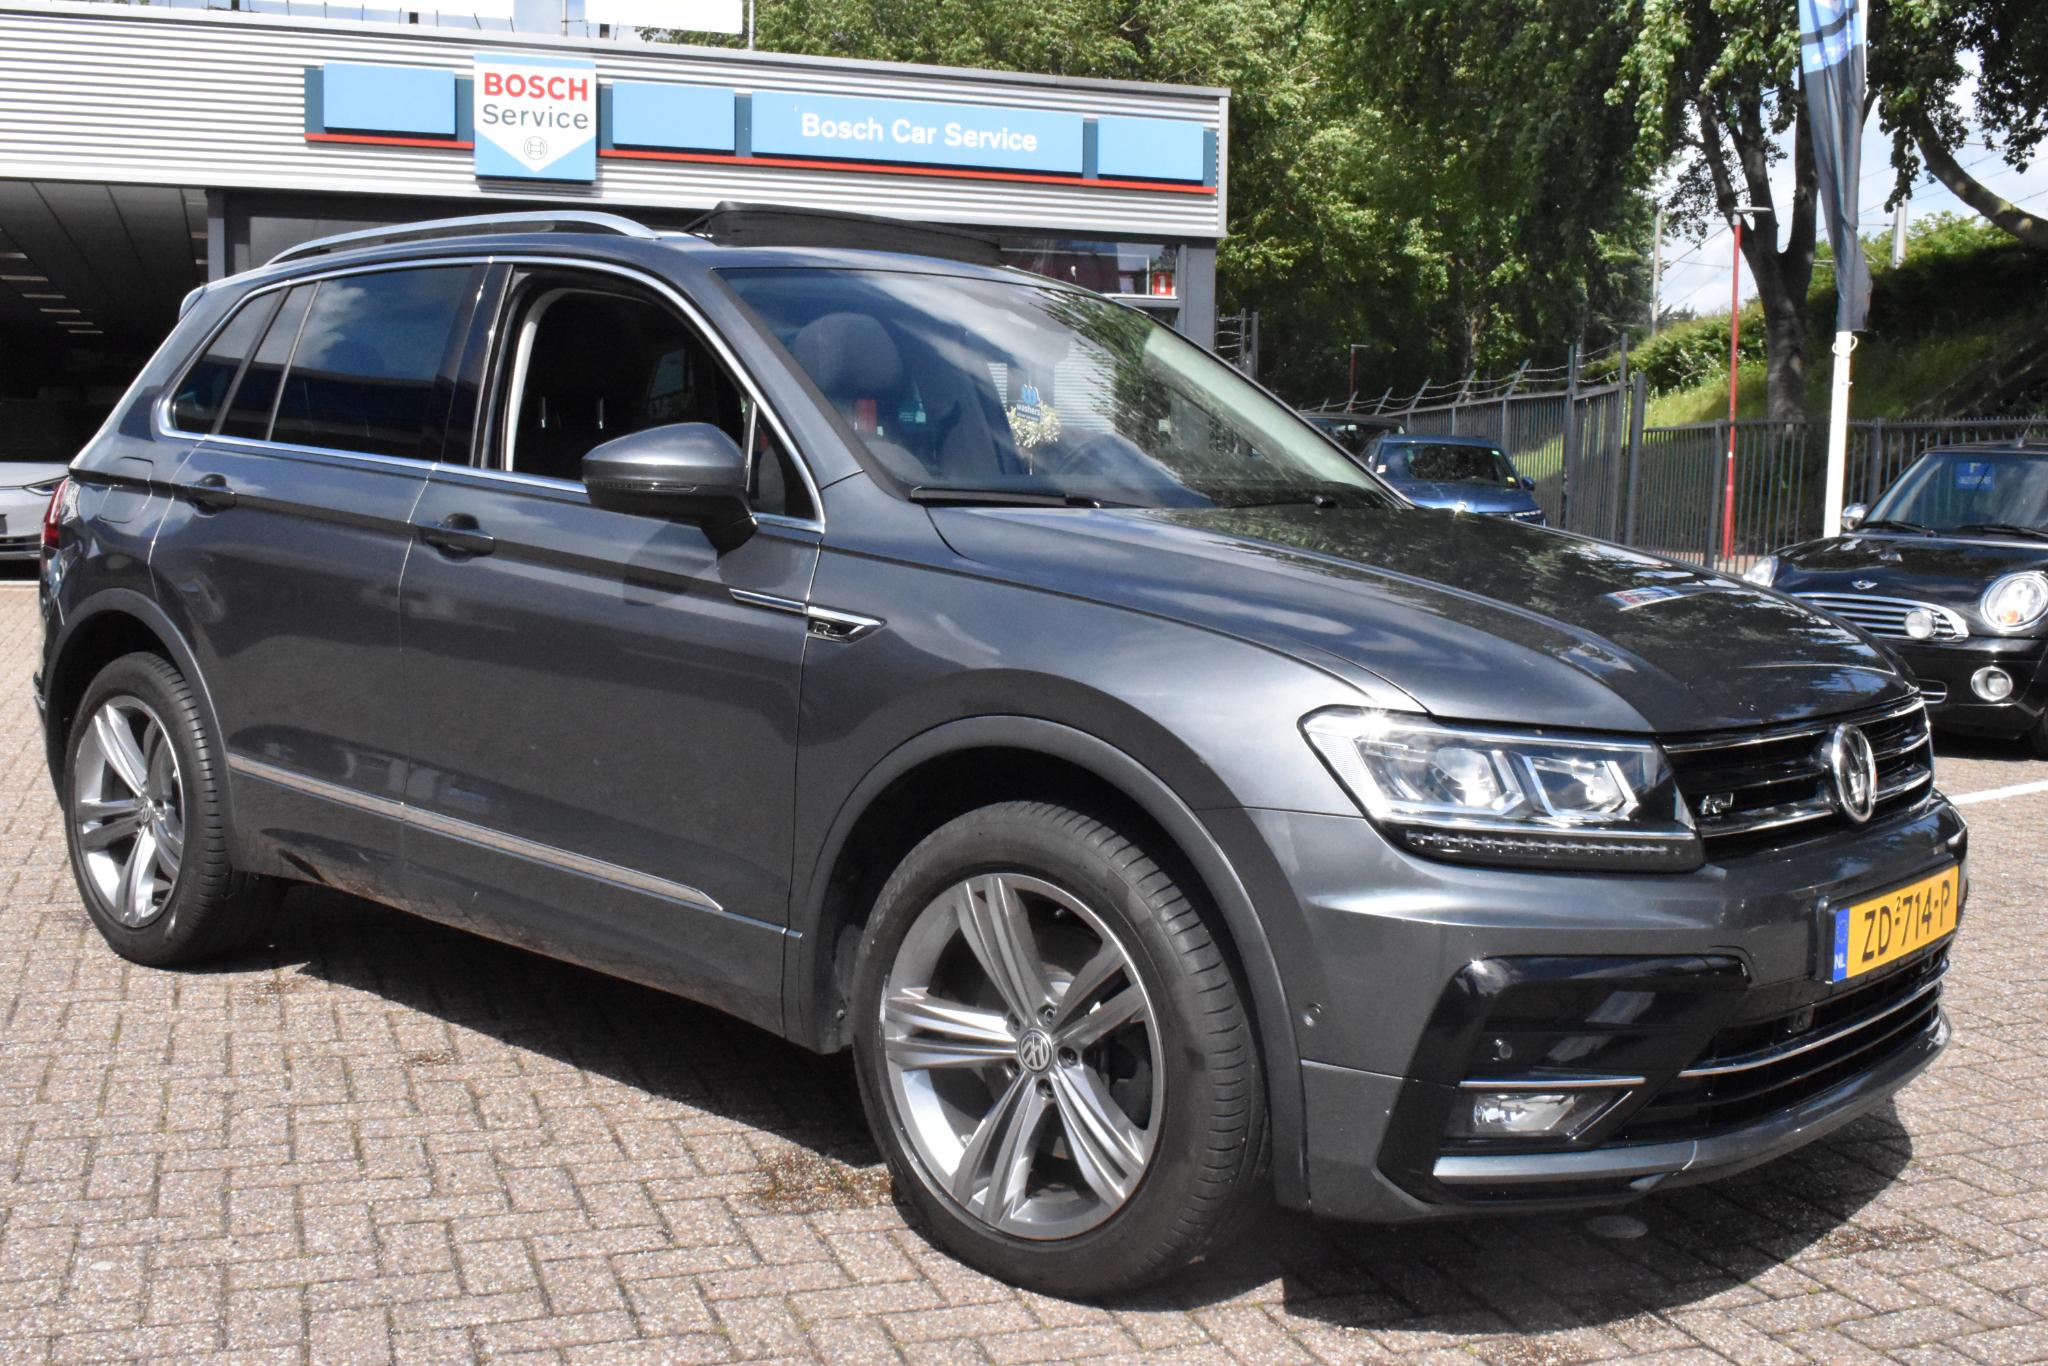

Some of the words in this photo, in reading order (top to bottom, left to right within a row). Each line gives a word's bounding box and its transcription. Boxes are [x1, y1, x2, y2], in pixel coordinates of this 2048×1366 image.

[484, 71, 588, 102] BOSCH
[482, 103, 589, 130] Service
[801, 112, 883, 141] Bosch
[891, 118, 937, 145] Car
[944, 122, 1037, 151] Service
[1016, 403, 1041, 417] washers
[1834, 953, 1846, 970] NL
